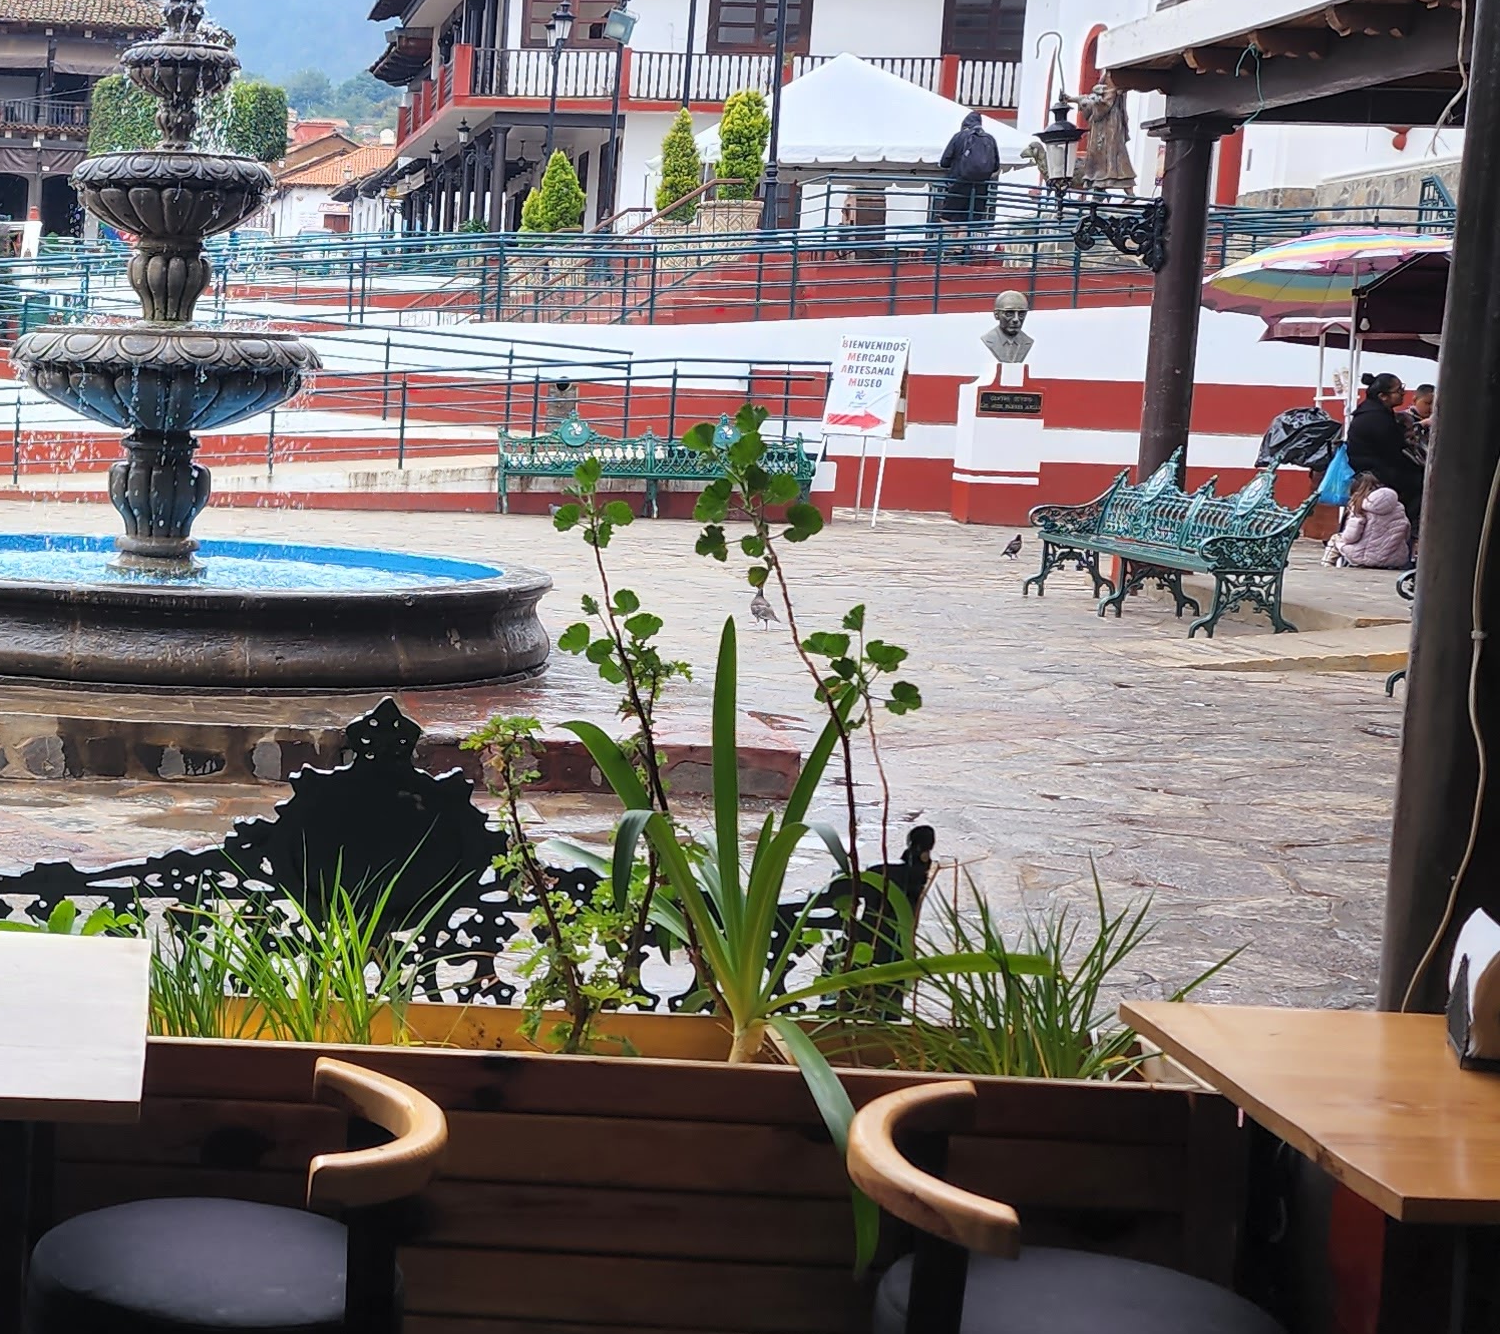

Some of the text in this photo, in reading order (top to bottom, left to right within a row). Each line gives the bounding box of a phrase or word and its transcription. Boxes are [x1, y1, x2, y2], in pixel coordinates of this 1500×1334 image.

[842, 339, 907, 351] BIENVENIDOS
[847, 352, 895, 364] MERCADO
[841, 364, 895, 376] ARTESANAL
[848, 377, 883, 388] MUSEO
